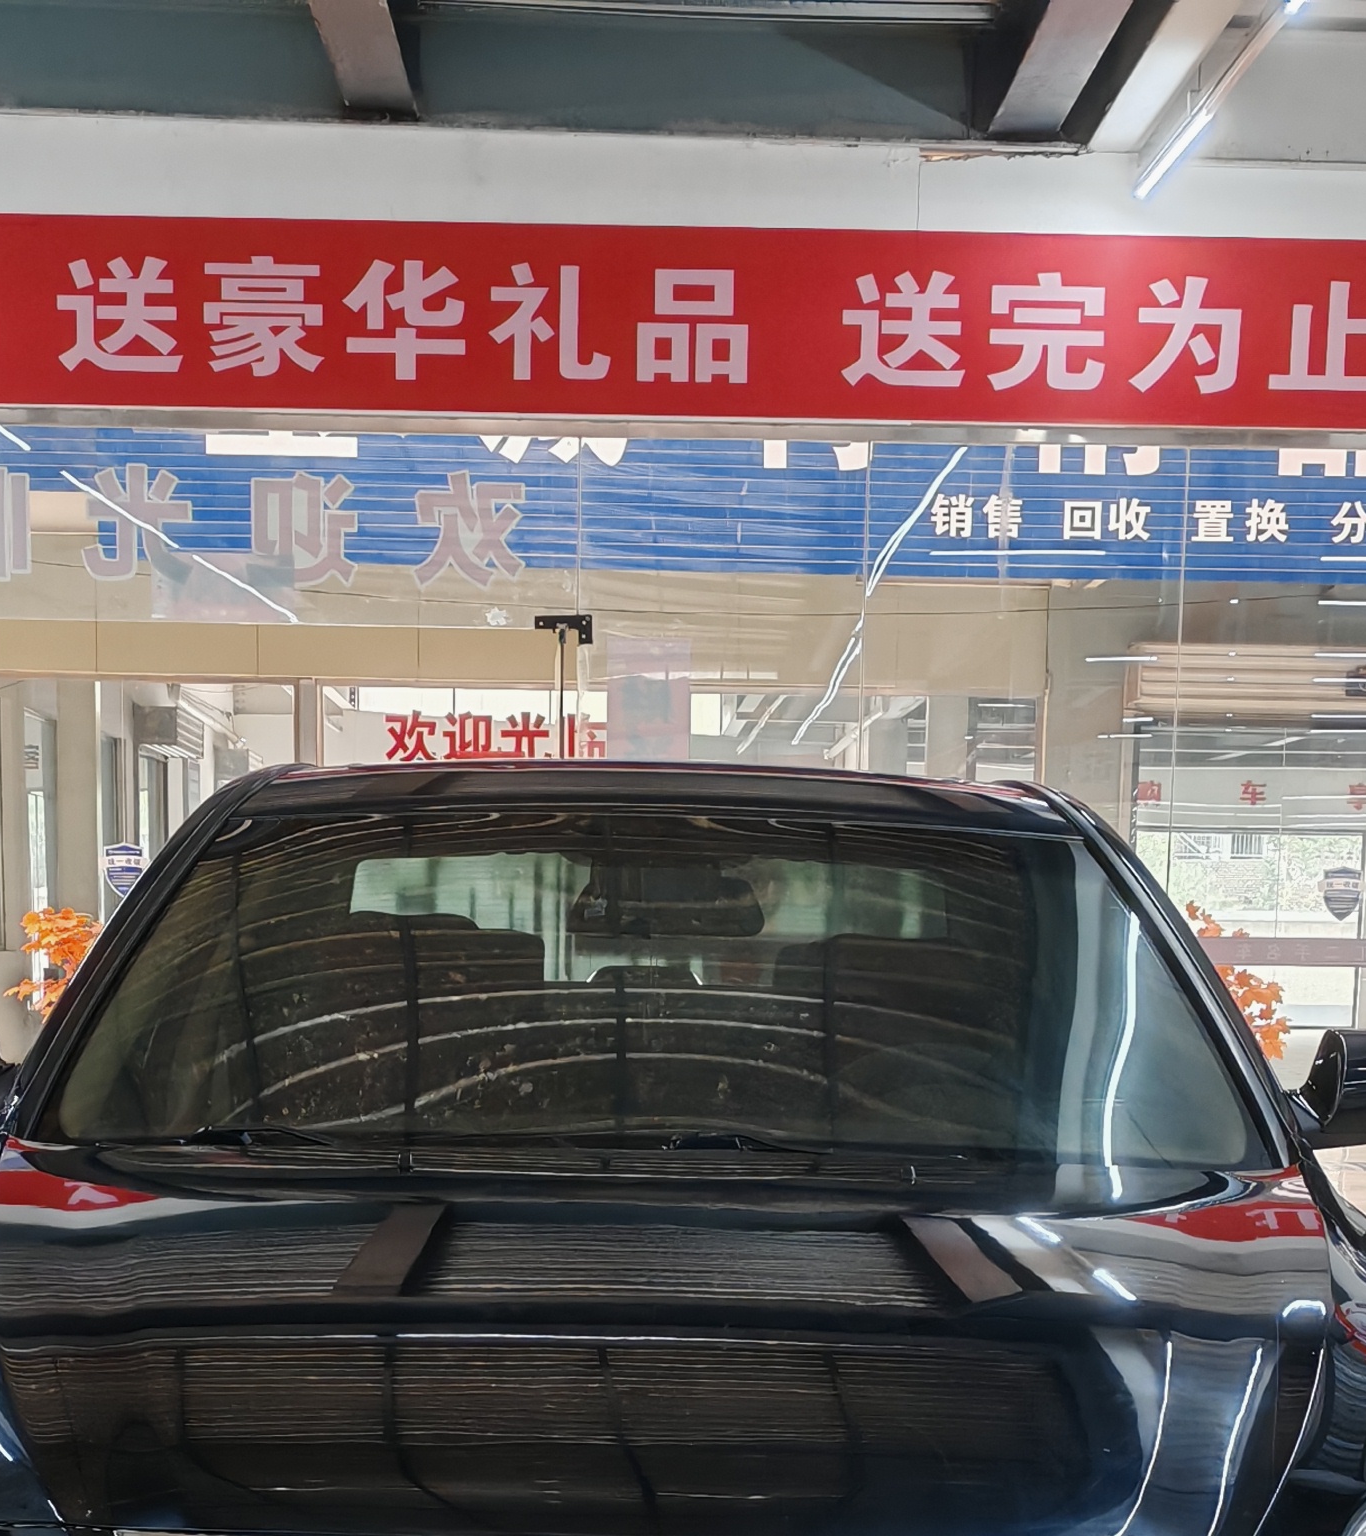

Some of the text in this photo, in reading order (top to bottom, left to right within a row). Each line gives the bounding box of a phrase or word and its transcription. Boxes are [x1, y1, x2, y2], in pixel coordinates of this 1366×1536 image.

[56, 255, 750, 384] 送豪华礼品
[930, 493, 1024, 540] 销售
[1062, 498, 1152, 541] 回收
[1191, 498, 1290, 544] 置换
[384, 709, 608, 760] 欢迎光临
